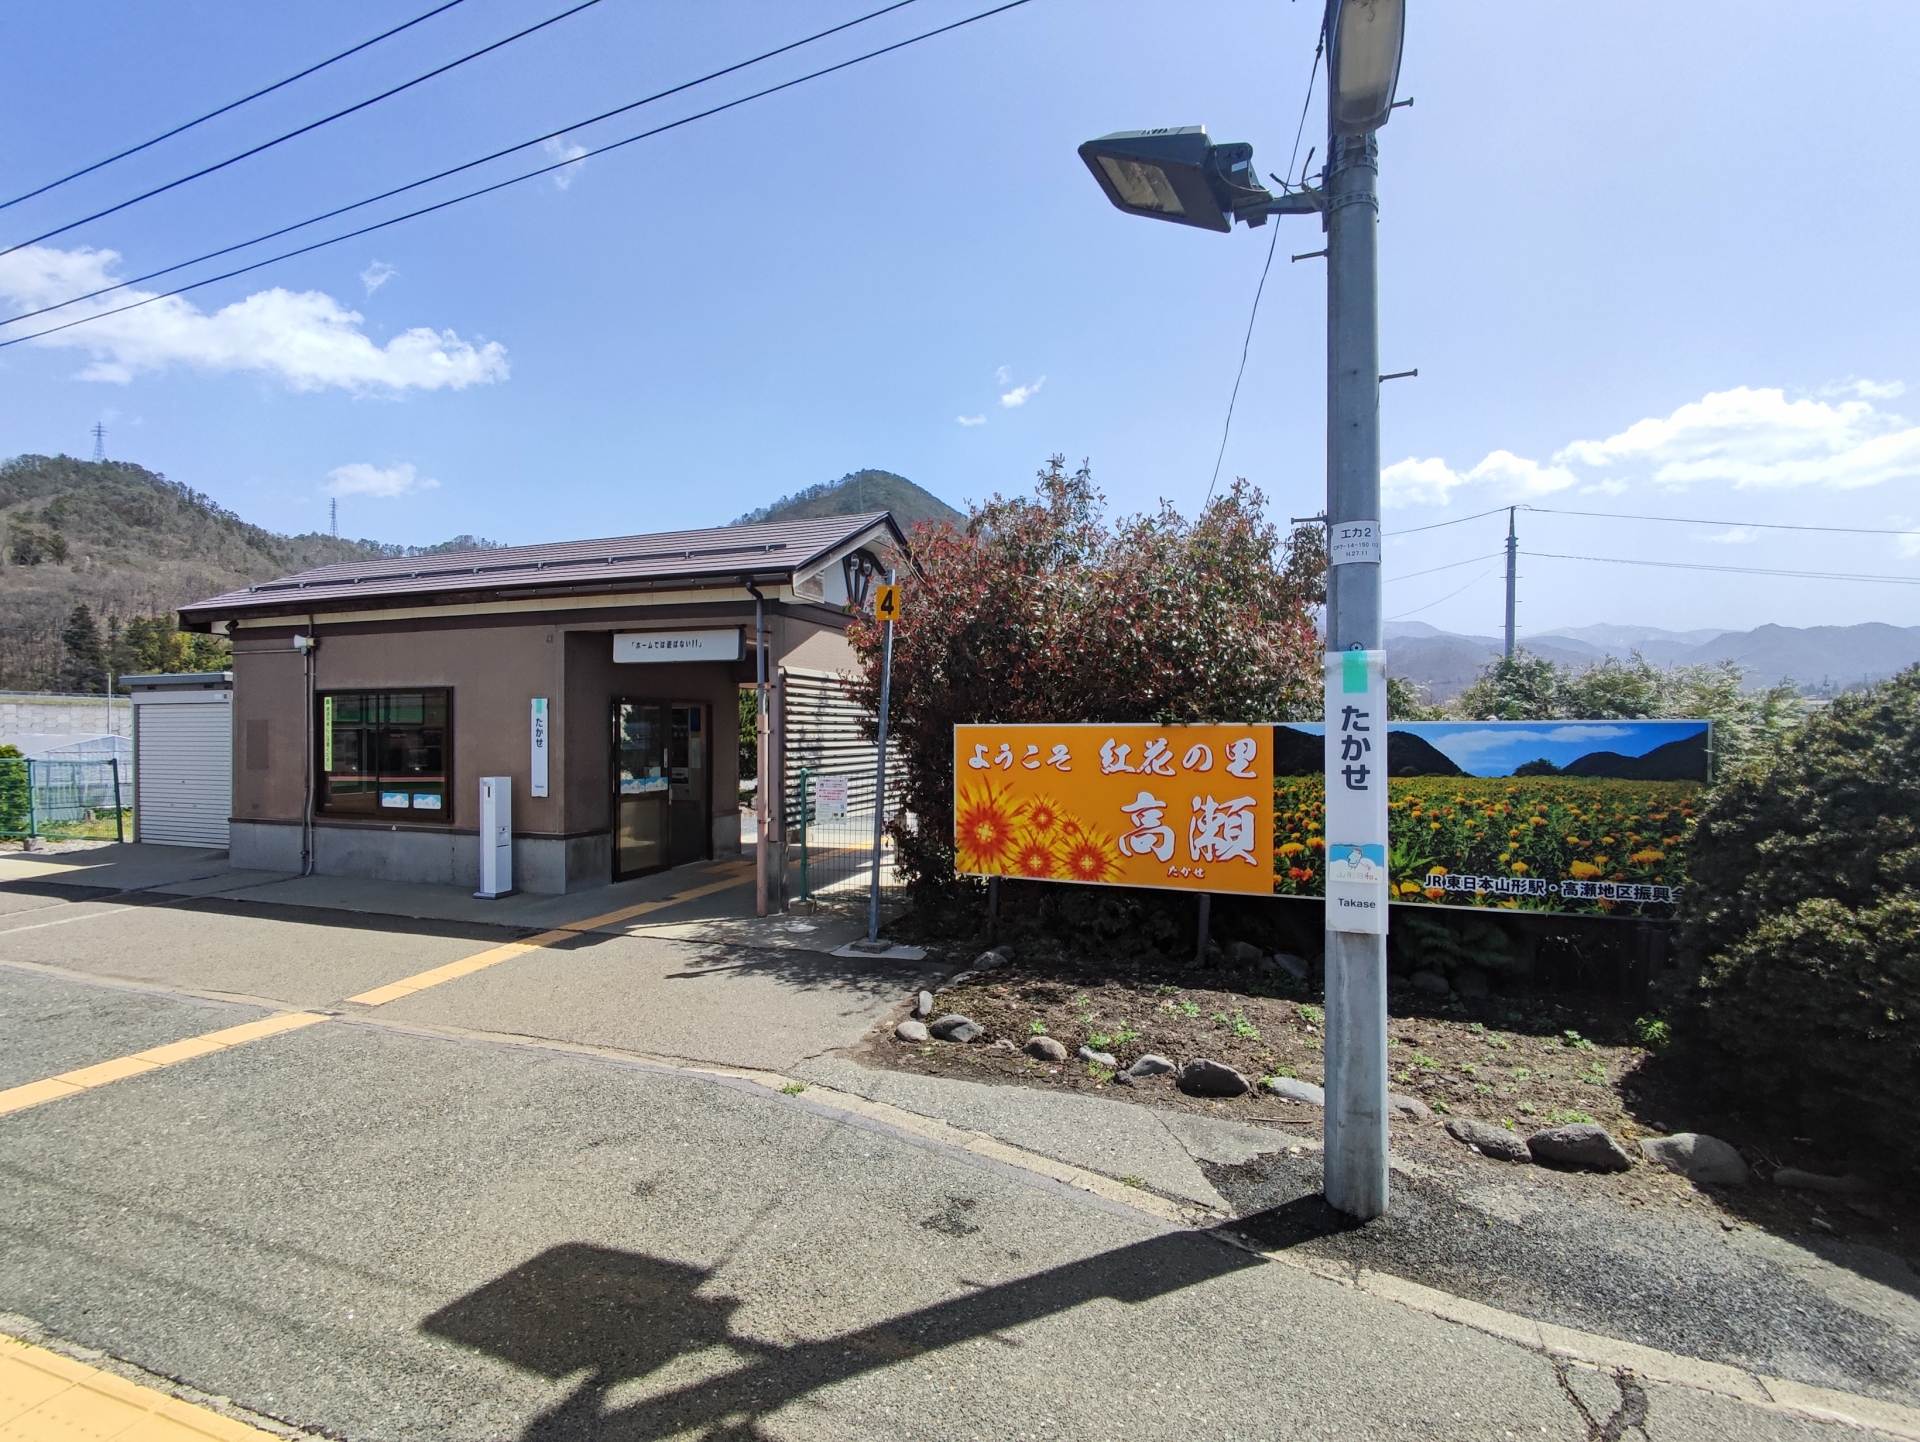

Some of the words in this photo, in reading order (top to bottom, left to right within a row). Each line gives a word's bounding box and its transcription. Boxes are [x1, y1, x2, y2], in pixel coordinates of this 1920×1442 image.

[880, 589, 894, 615] 4
[535, 717, 544, 748] たかせ
[1340, 705, 1371, 791] たかせ
[968, 743, 1072, 771] ようこそ
[1099, 738, 1258, 779] 紅花の里
[1118, 791, 1258, 866] 高瀬
[1168, 865, 1205, 879] たかせ
[1338, 897, 1376, 909] Takase
